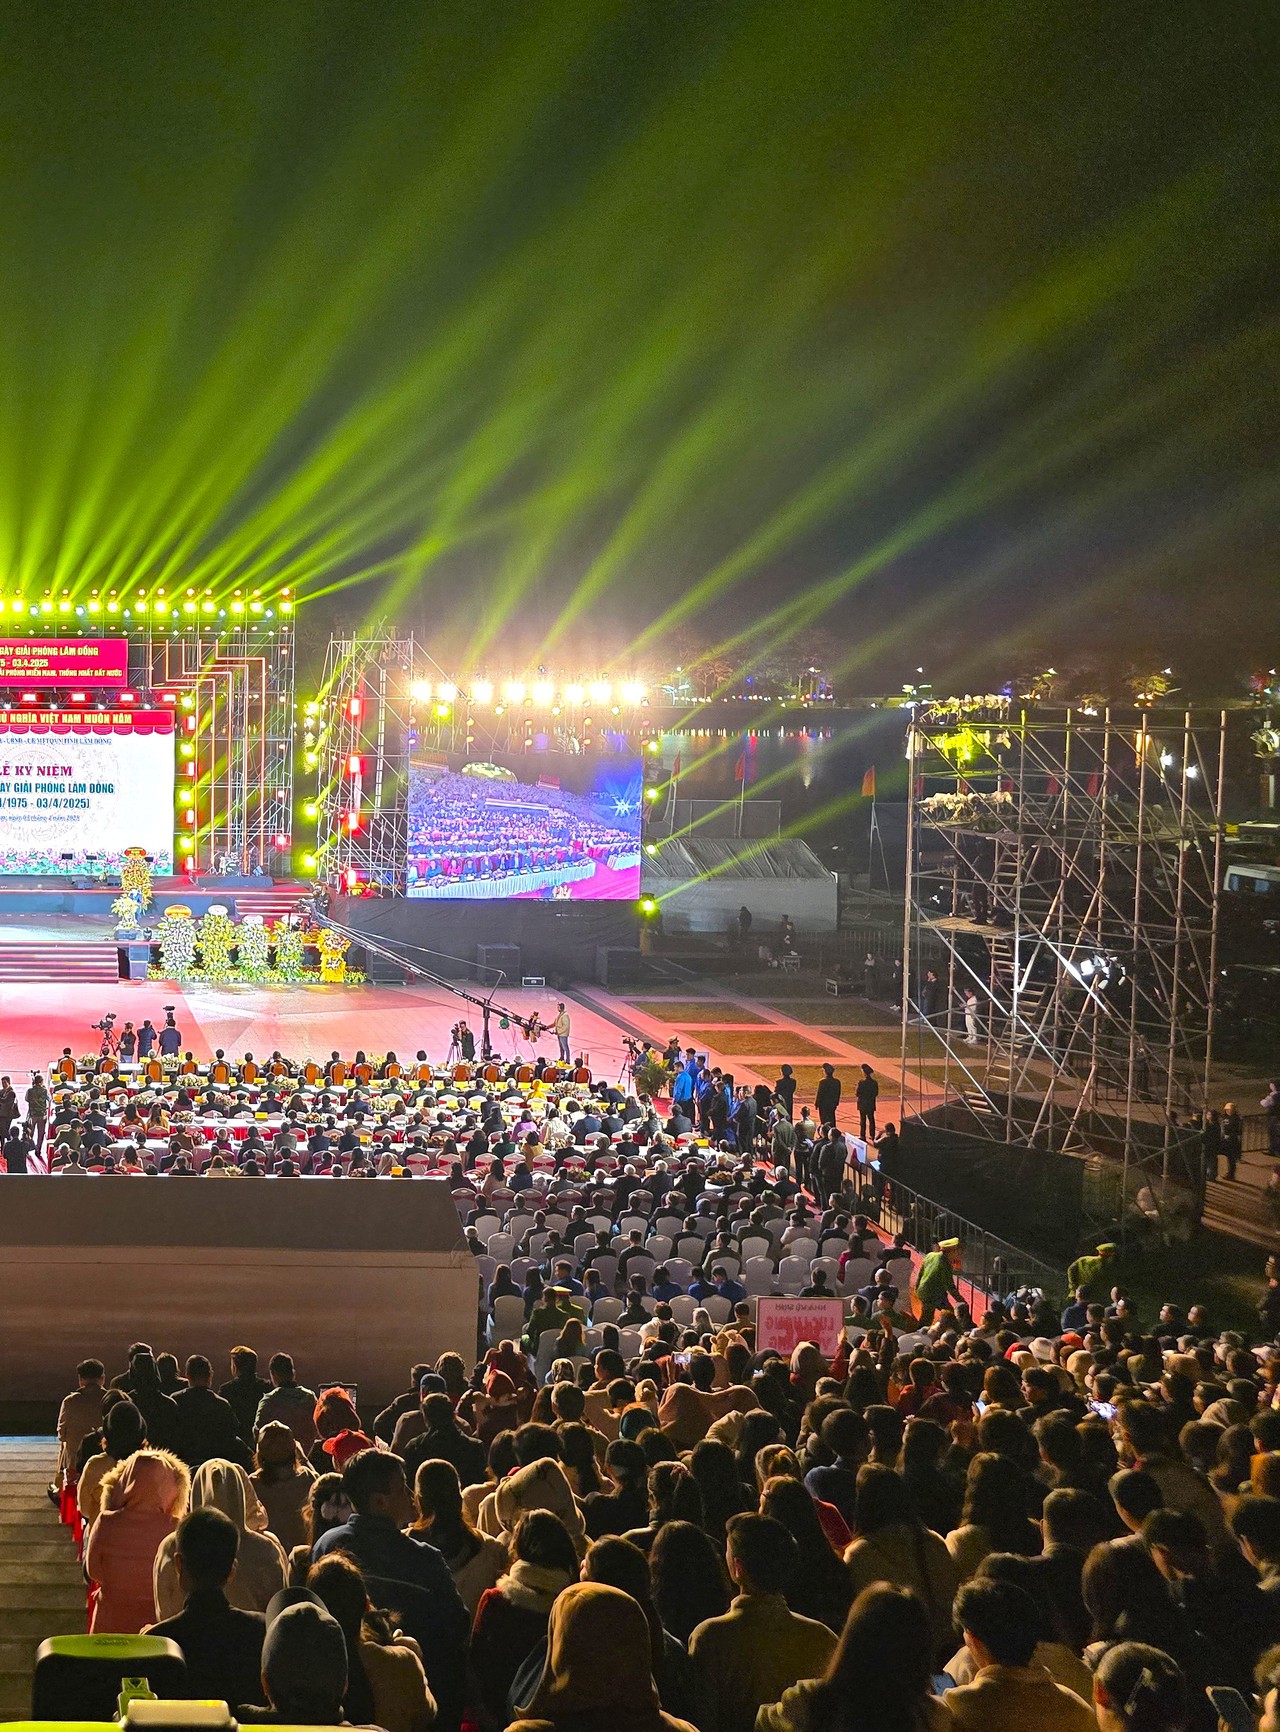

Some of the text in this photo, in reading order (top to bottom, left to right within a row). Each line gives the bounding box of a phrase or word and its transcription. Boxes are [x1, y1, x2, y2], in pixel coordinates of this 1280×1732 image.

[15, 645, 30, 655] GIẢI
[32, 645, 58, 656] PHÓNG
[60, 646, 76, 656] LÂM
[77, 645, 99, 656] ĐỒNG
[12, 658, 49, 668] 03.4.2025
[10, 712, 37, 723] NGHĨA
[39, 712, 59, 724] VIỆT
[62, 713, 81, 723] NAM
[83, 712, 110, 723] MUÔN
[112, 712, 132, 723] NĂM
[36, 763, 73, 778] NIỆM
[14, 780, 32, 793] GIẢI
[35, 781, 65, 793] PHÓNG
[68, 780, 86, 793] LÂM
[89, 779, 114, 793] ĐỒNG
